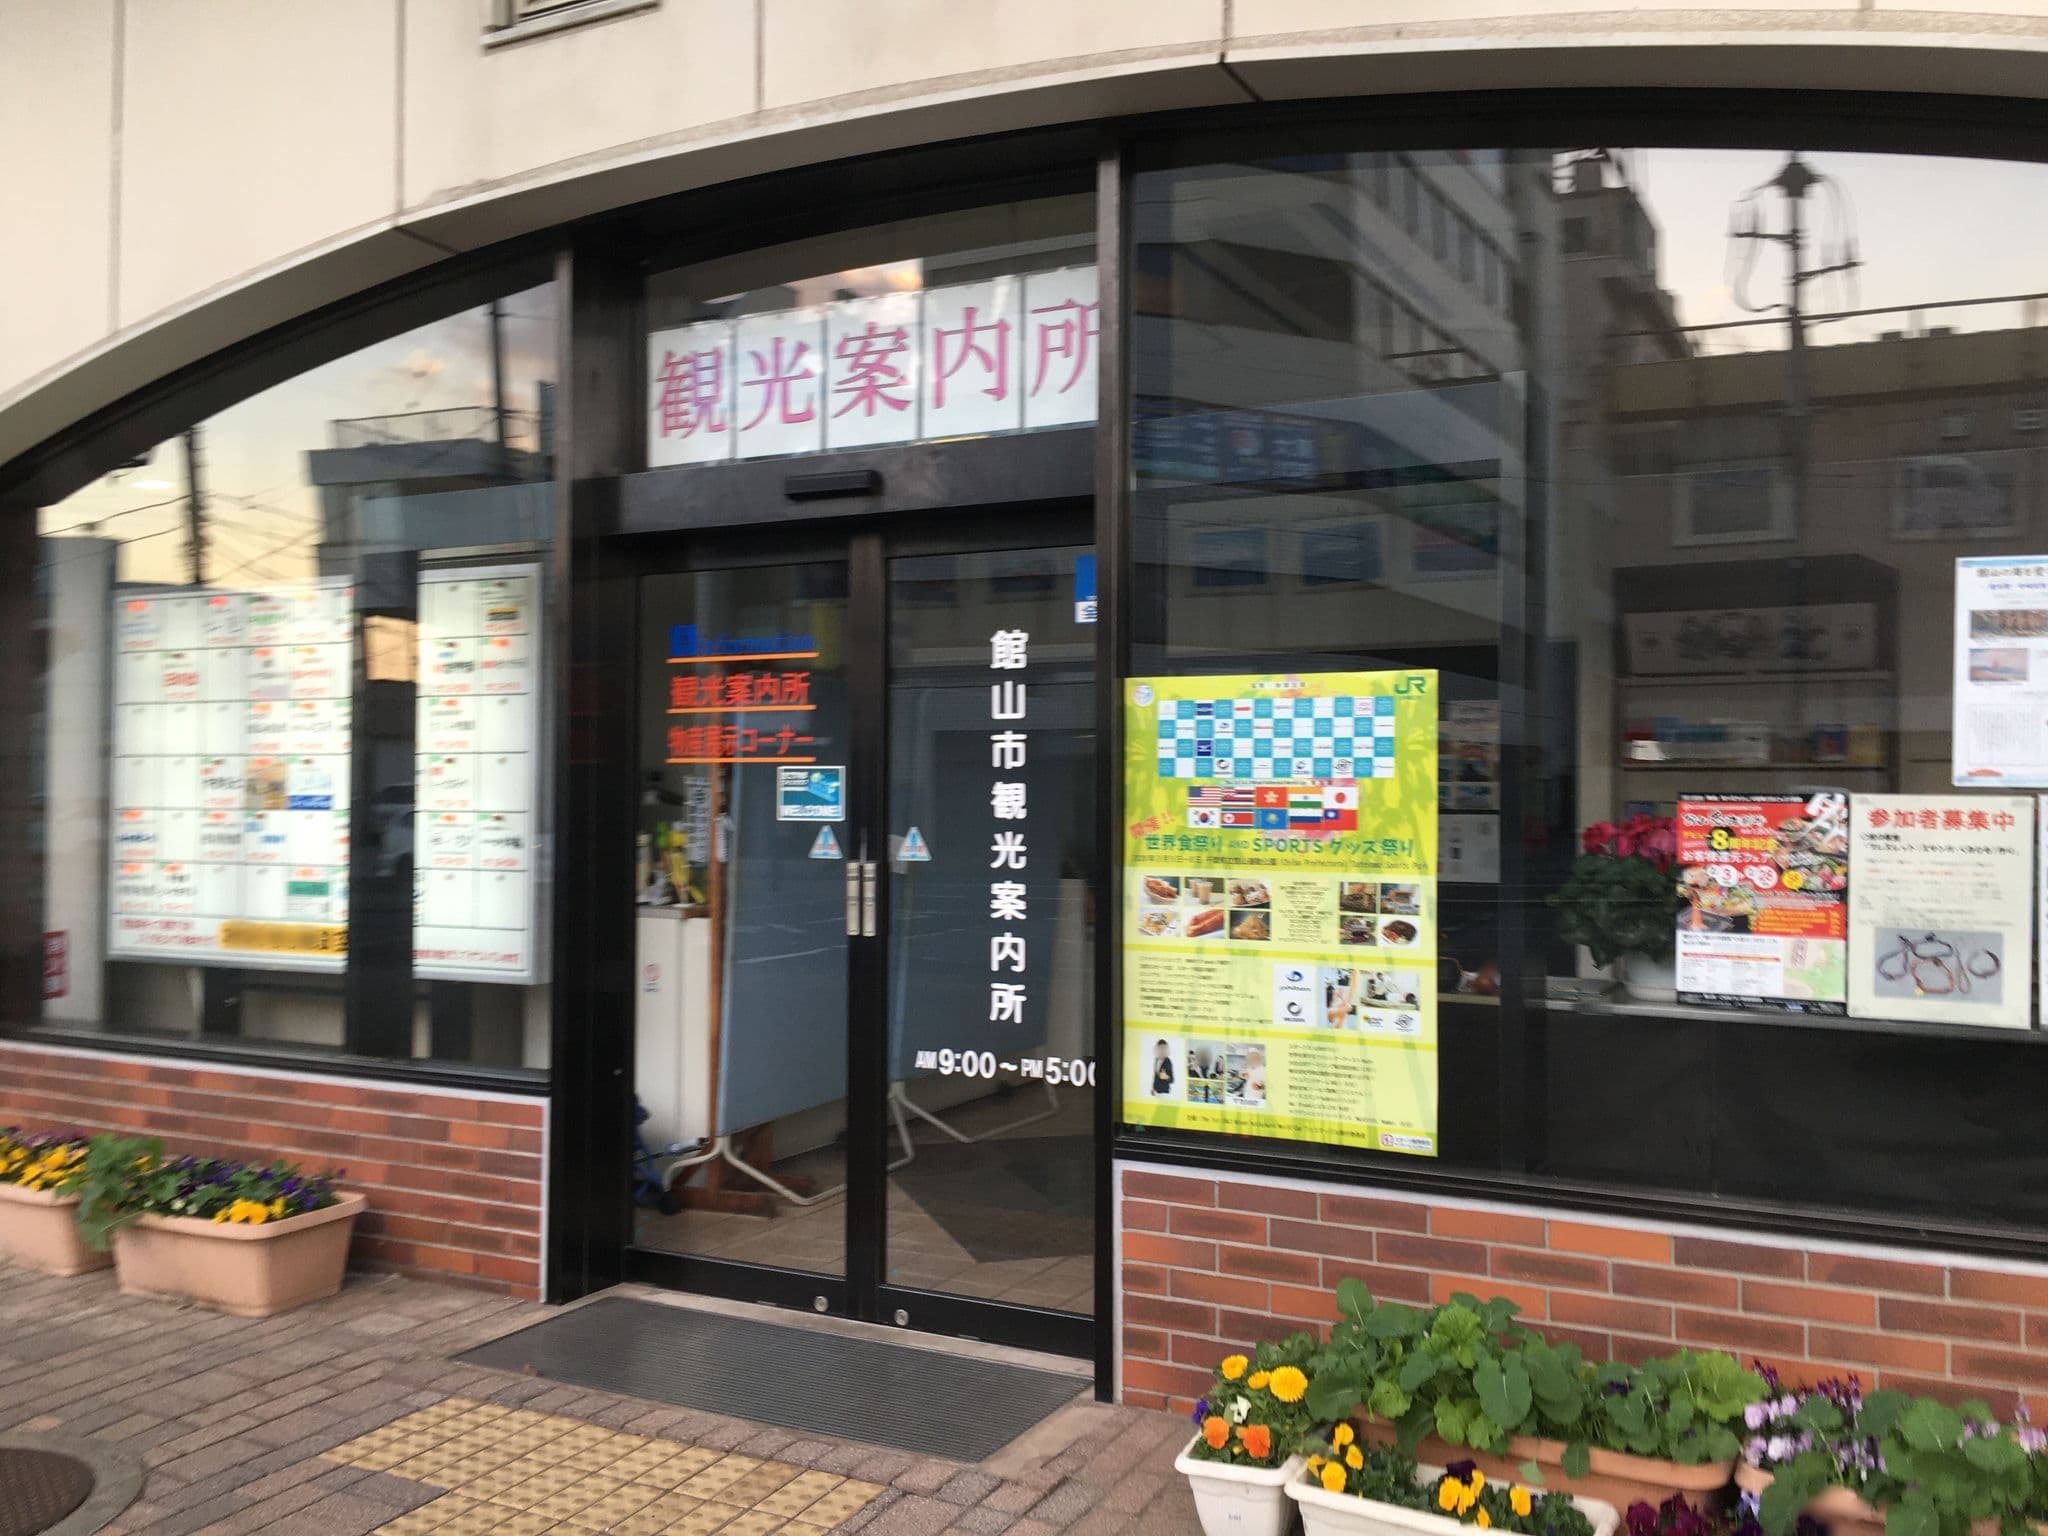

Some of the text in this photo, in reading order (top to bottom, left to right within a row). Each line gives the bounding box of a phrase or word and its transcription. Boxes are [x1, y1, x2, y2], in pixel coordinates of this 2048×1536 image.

[656, 298, 1099, 440] 観光案内所
[669, 671, 812, 707] 観光案内所
[1394, 675, 1427, 696] JR
[988, 628, 1030, 1025] 館山市観光案内所
[1867, 807, 2016, 832] 参加者募集中
[1252, 837, 1323, 854] SPORTS
